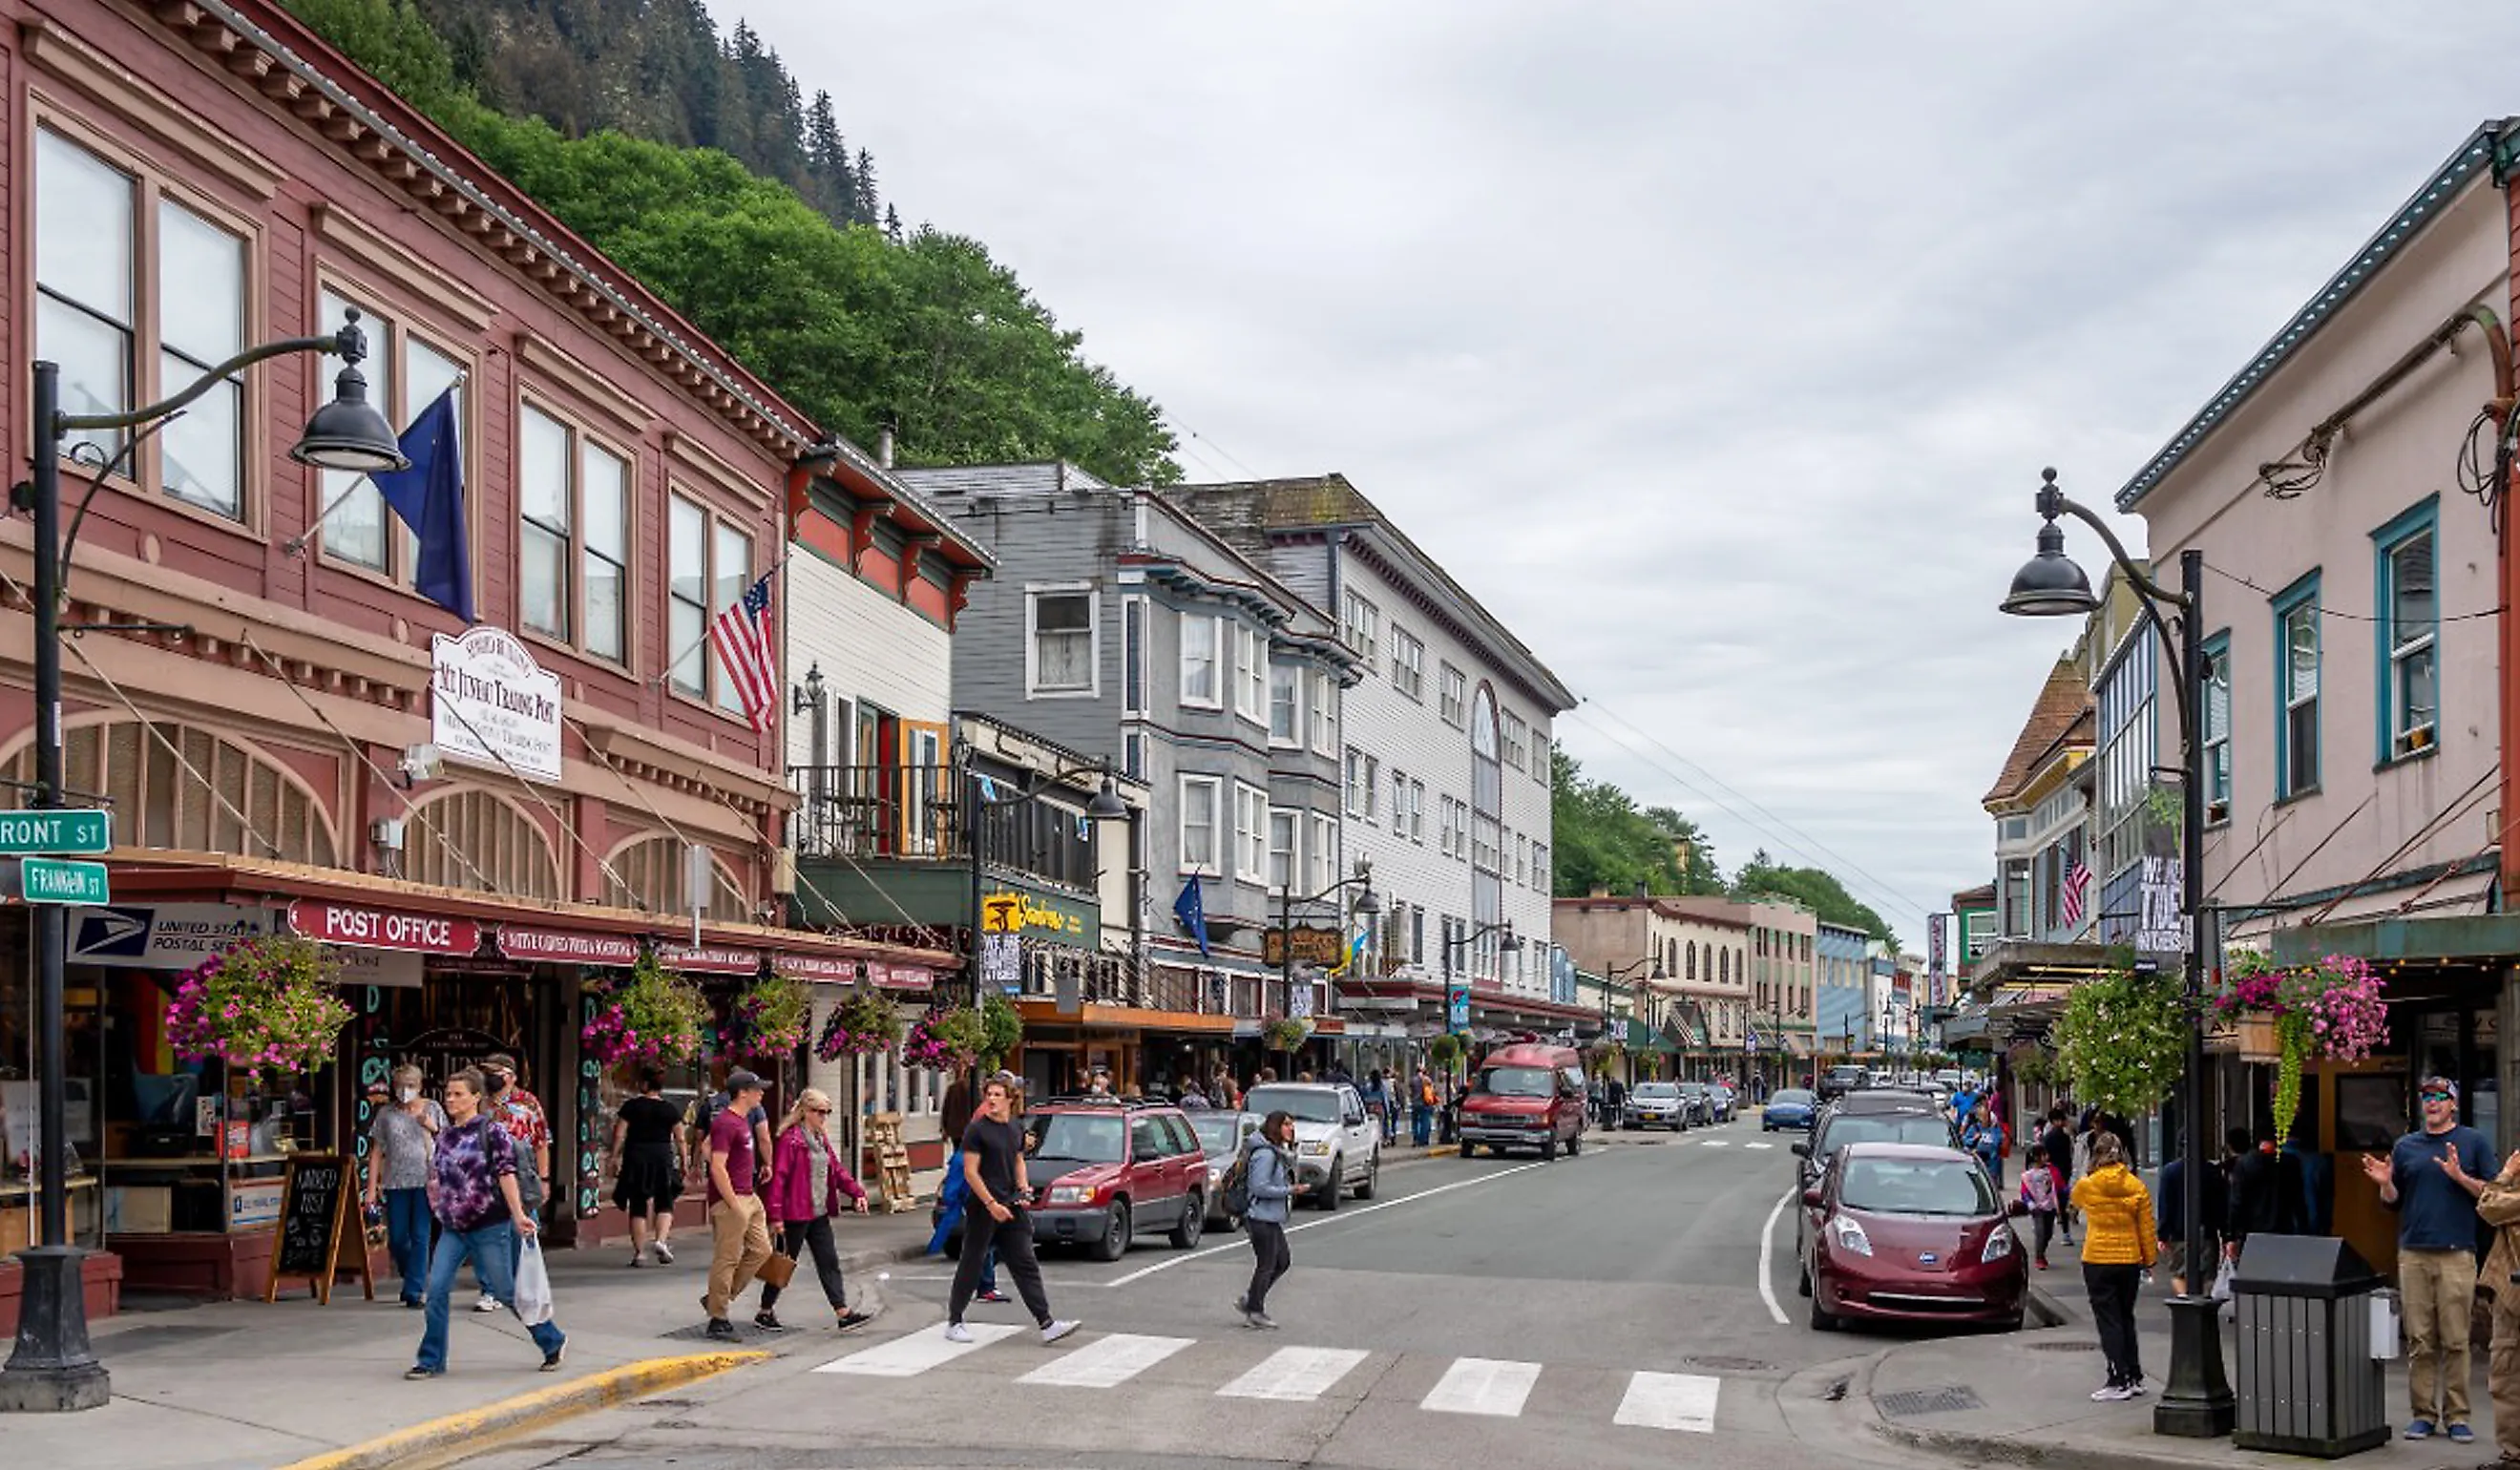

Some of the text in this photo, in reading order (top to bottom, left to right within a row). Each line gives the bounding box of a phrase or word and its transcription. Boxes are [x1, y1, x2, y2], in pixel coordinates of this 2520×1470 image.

[0, 820, 98, 844] RONT ST
[32, 868, 99, 895] FRANKLIN ST
[158, 921, 209, 934] UNITED
[326, 906, 451, 946] POST OFFICE
[153, 936, 205, 952] POSTAL
